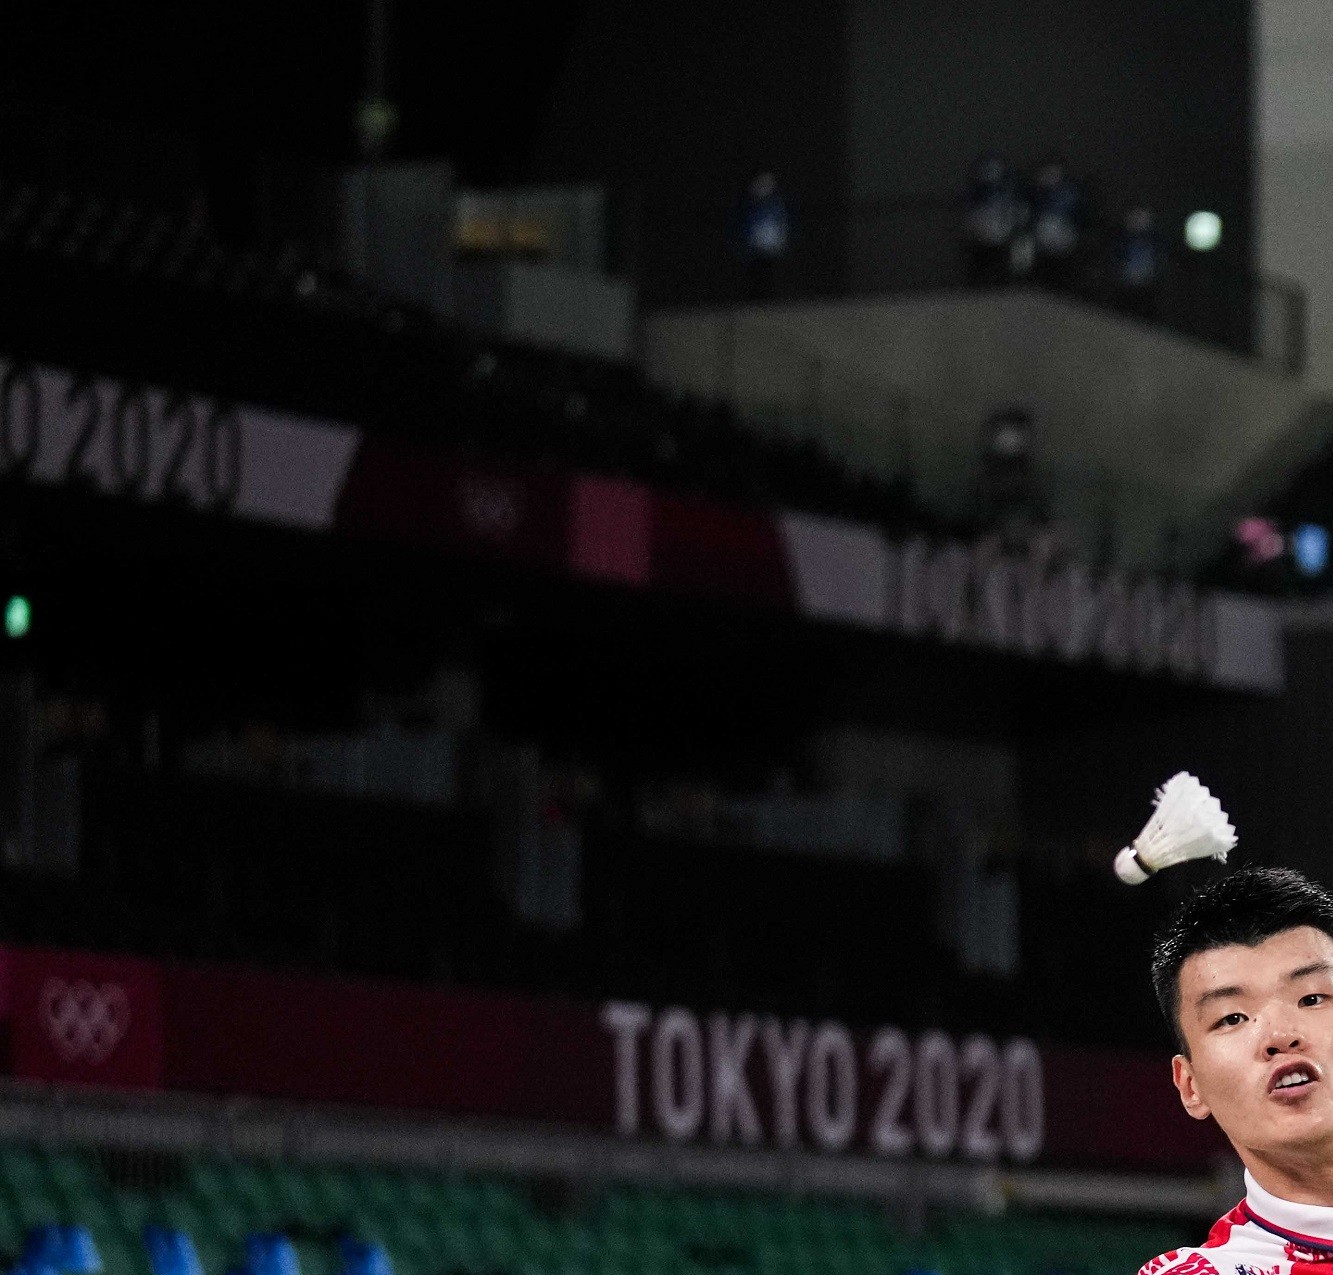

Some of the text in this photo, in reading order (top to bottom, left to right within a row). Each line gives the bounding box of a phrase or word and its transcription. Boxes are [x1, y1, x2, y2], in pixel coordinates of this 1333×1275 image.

[62, 371, 244, 509] 2020
[601, 1000, 1047, 1163] TOKYO 2020
